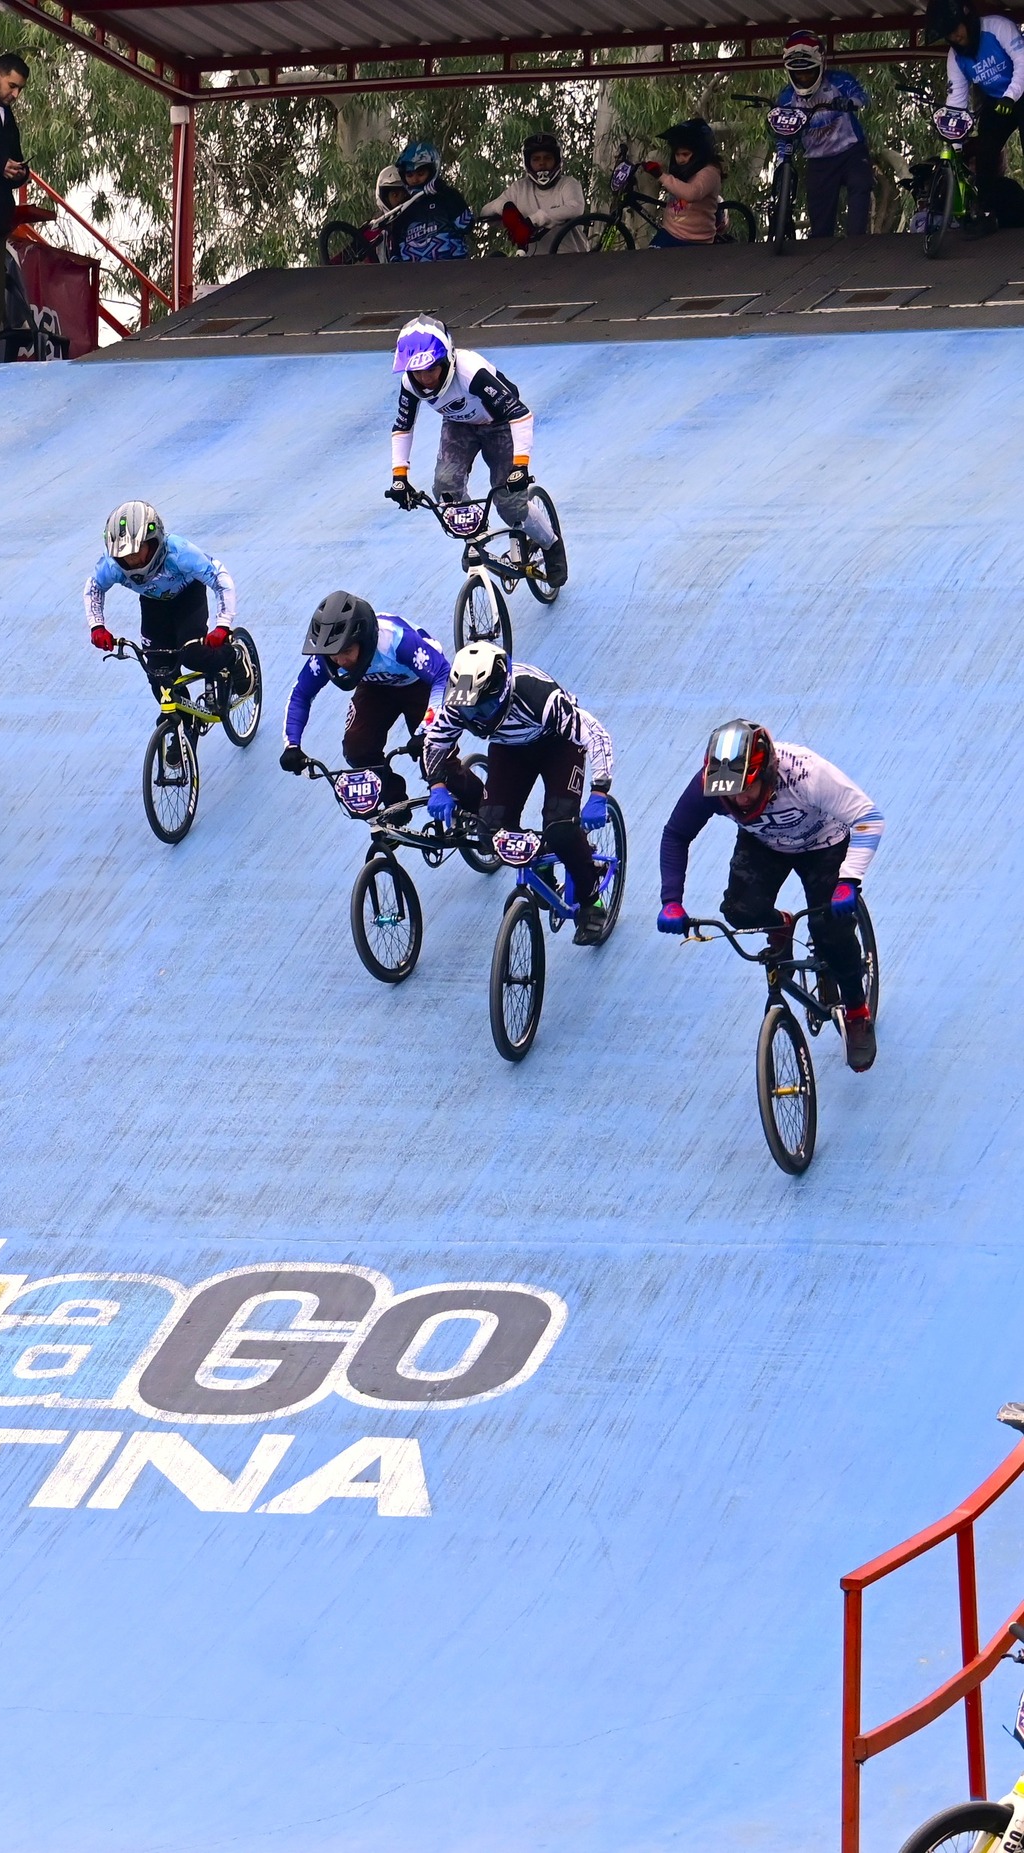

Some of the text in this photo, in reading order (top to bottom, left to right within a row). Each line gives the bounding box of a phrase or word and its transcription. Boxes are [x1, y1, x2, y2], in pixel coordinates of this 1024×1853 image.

[972, 55, 997, 75] TEAM
[777, 116, 797, 125] 159
[454, 512, 475, 524] 162
[447, 689, 477, 701] FLY
[347, 782, 372, 798] 148
[710, 779, 735, 793] FLY
[505, 839, 527, 852] 59
